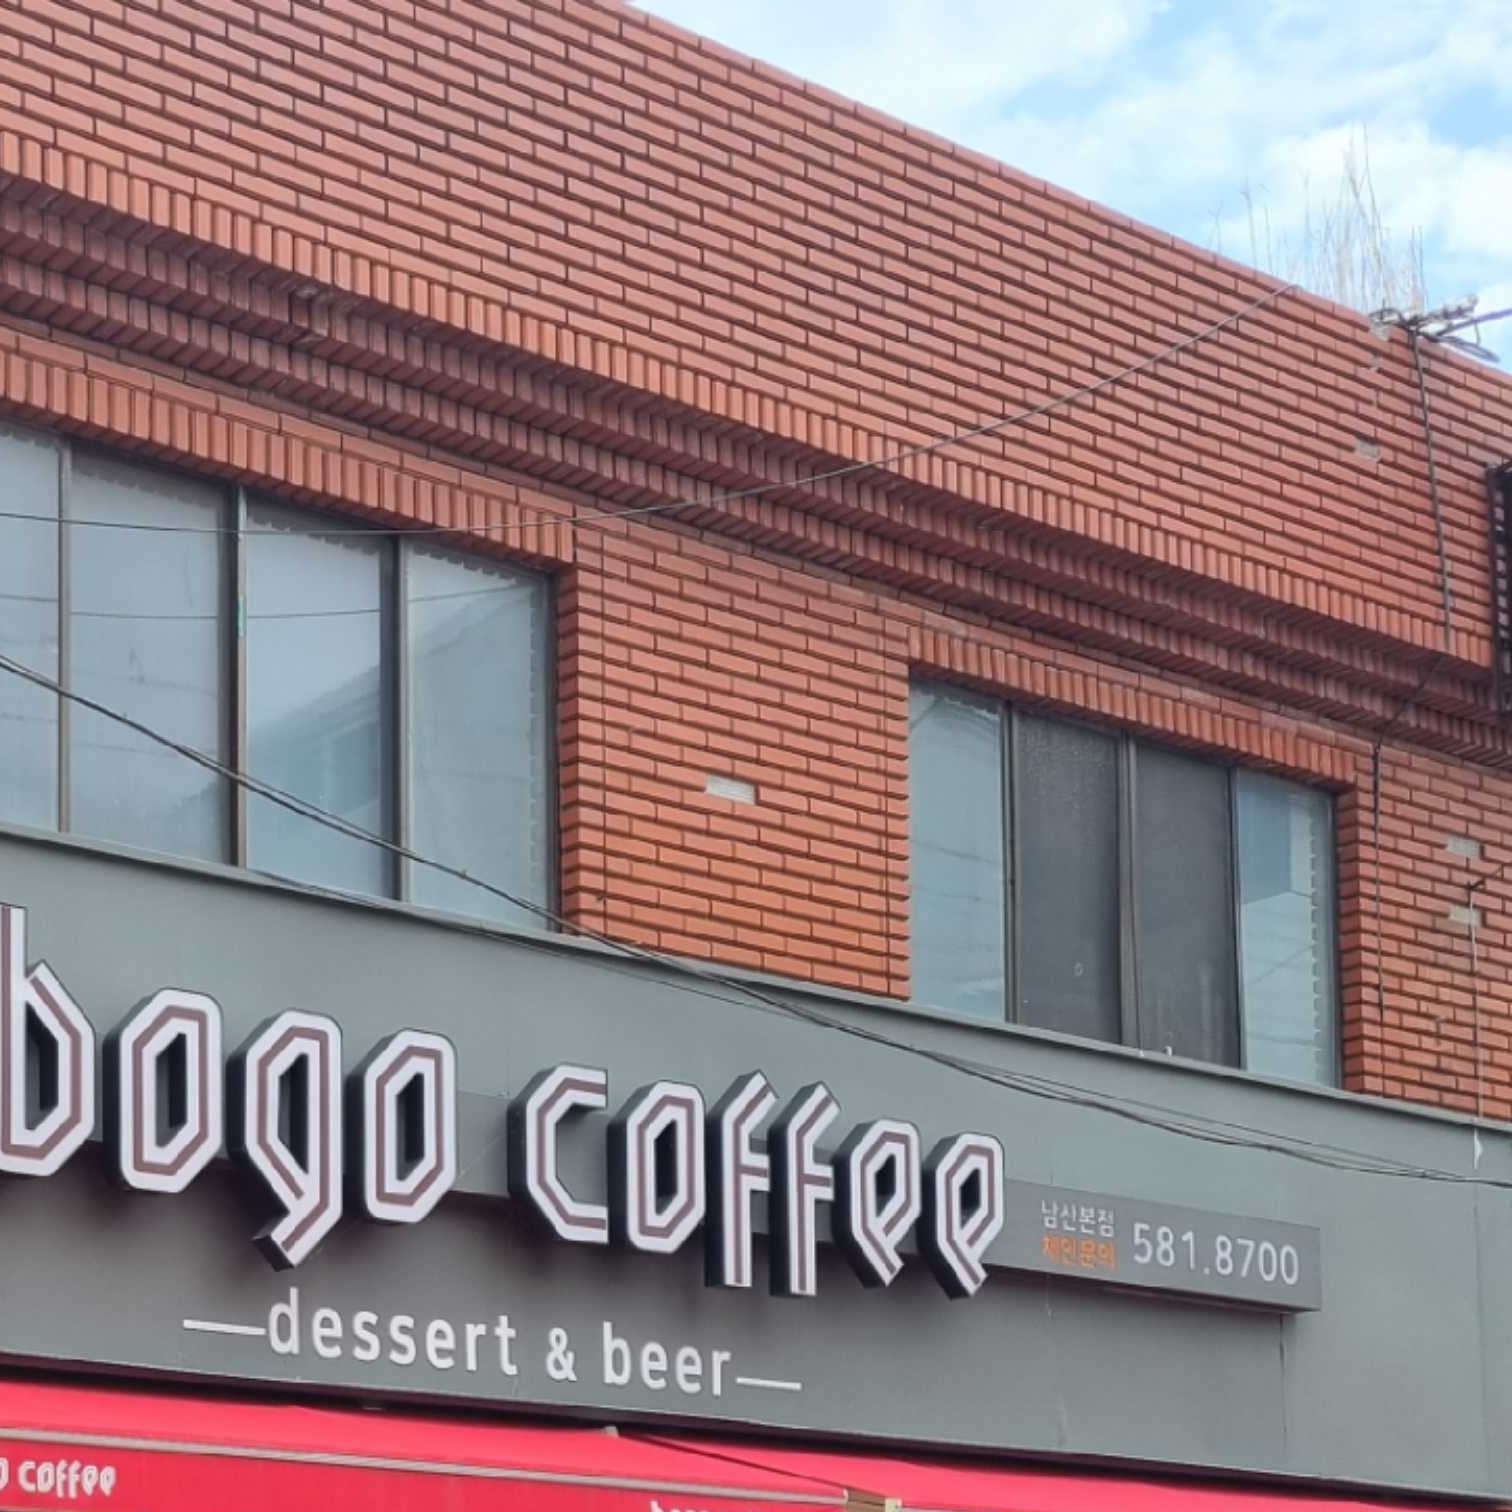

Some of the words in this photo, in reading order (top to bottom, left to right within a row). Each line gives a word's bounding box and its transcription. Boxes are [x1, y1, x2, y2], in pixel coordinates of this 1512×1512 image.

[518, 1063, 1005, 1298] coffee
[1133, 1222, 1299, 1286] 581.8700
[267, 1286, 518, 1377] dessert
[545, 1326, 578, 1382] &
[601, 1320, 732, 1398] beer
[18, 1459, 116, 1499] coffee
